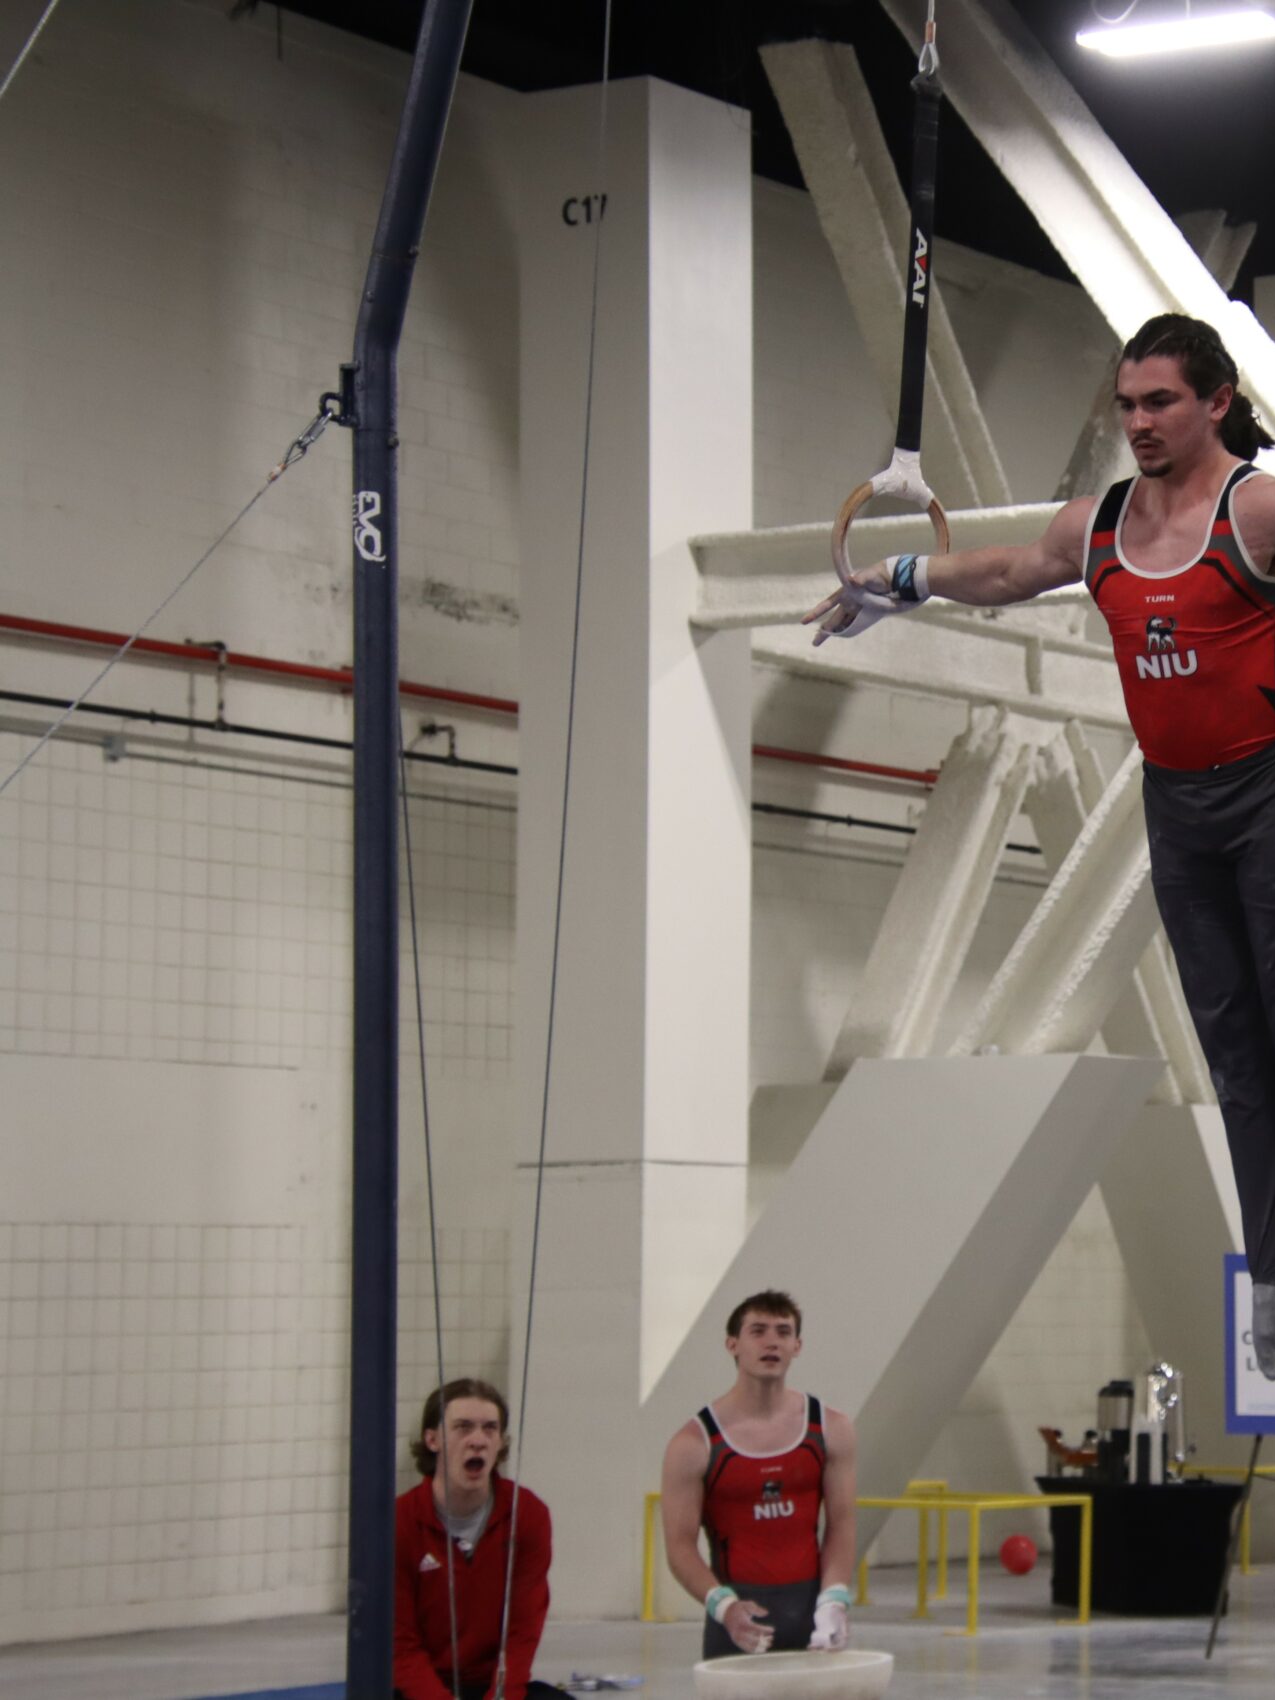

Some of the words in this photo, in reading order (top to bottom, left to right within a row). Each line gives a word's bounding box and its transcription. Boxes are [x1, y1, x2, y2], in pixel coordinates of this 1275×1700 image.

[1144, 594, 1175, 604] TURN
[1135, 649, 1198, 680] NIU
[753, 1499, 795, 1521] NIU
